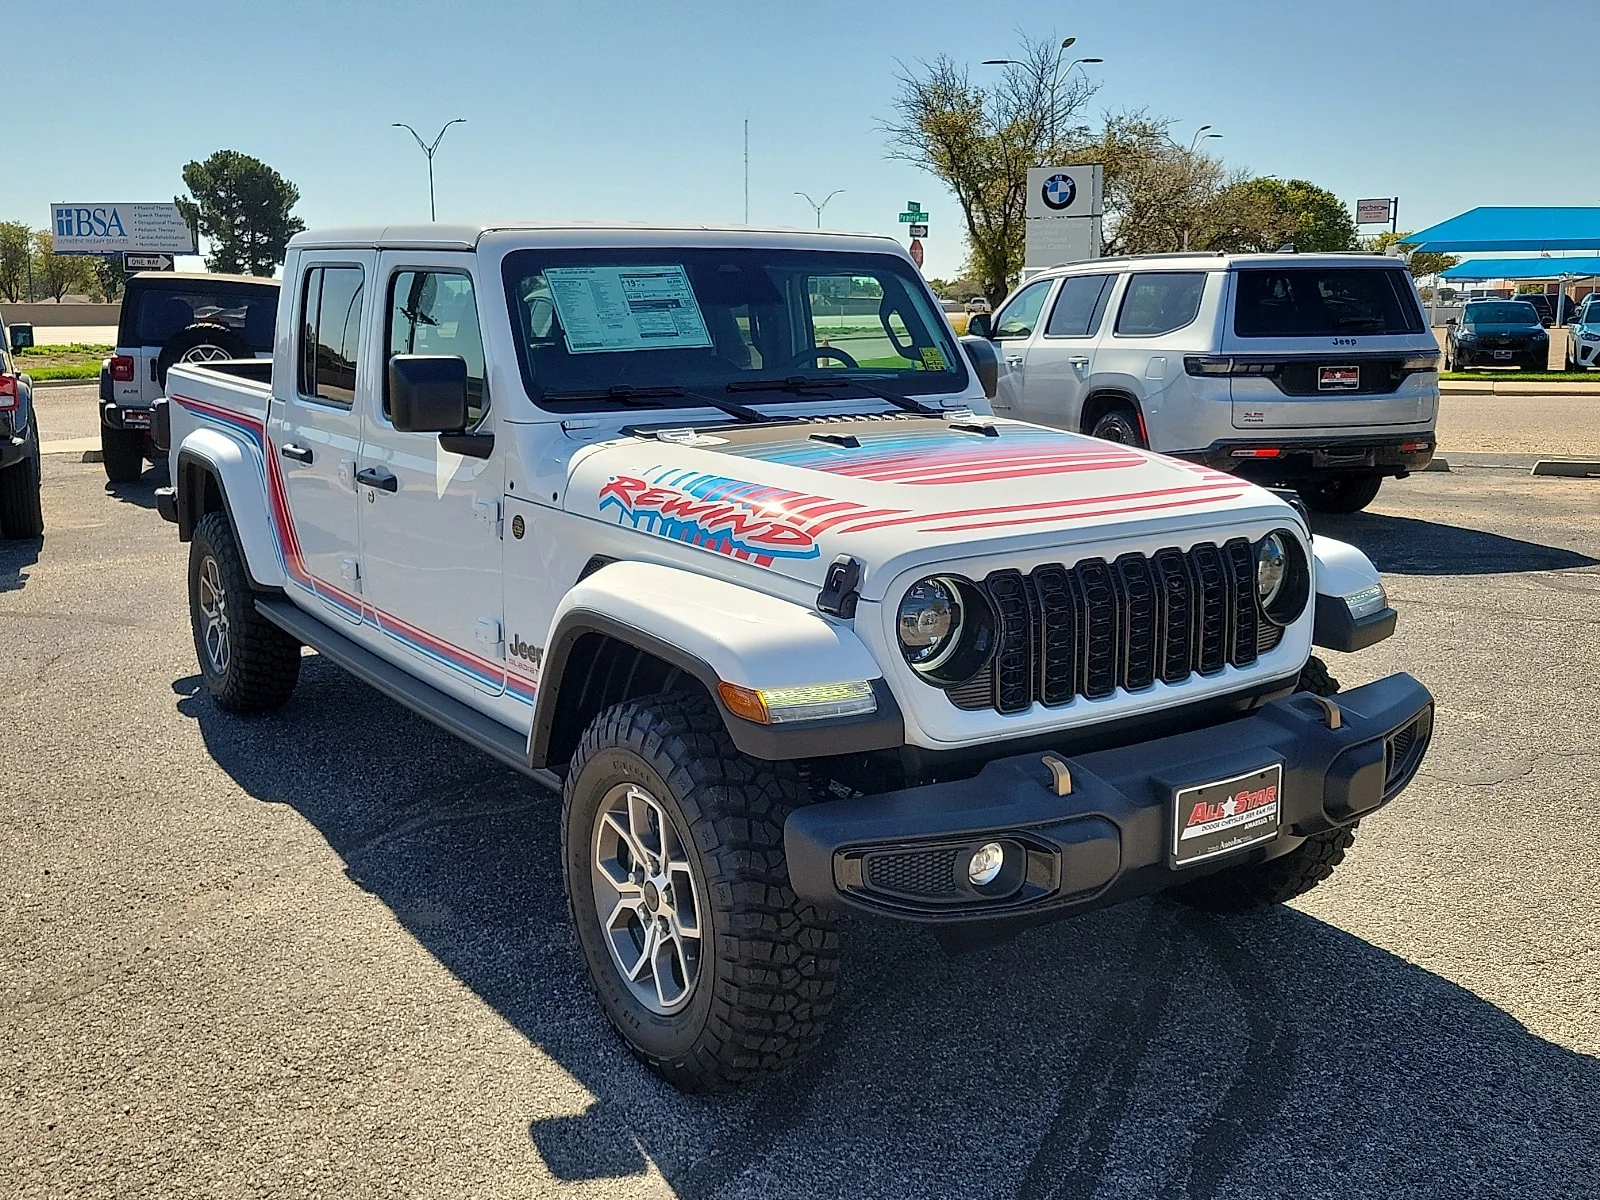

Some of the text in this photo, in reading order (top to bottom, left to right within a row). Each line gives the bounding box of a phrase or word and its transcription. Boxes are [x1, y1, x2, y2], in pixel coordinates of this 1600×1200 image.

[1044, 175, 1074, 187] BMW
[73, 207, 127, 237] BSA
[131, 258, 160, 266] ONE WAY
[626, 279, 637, 287] 19
[1332, 338, 1357, 346] Jeep
[600, 476, 813, 546] REWIND
[508, 658, 539, 675] GLADIAT
[1187, 785, 1276, 826] ALL STAR
[1201, 804, 1276, 831] DODGE CHRYSLER JEEP RAM FIAT
